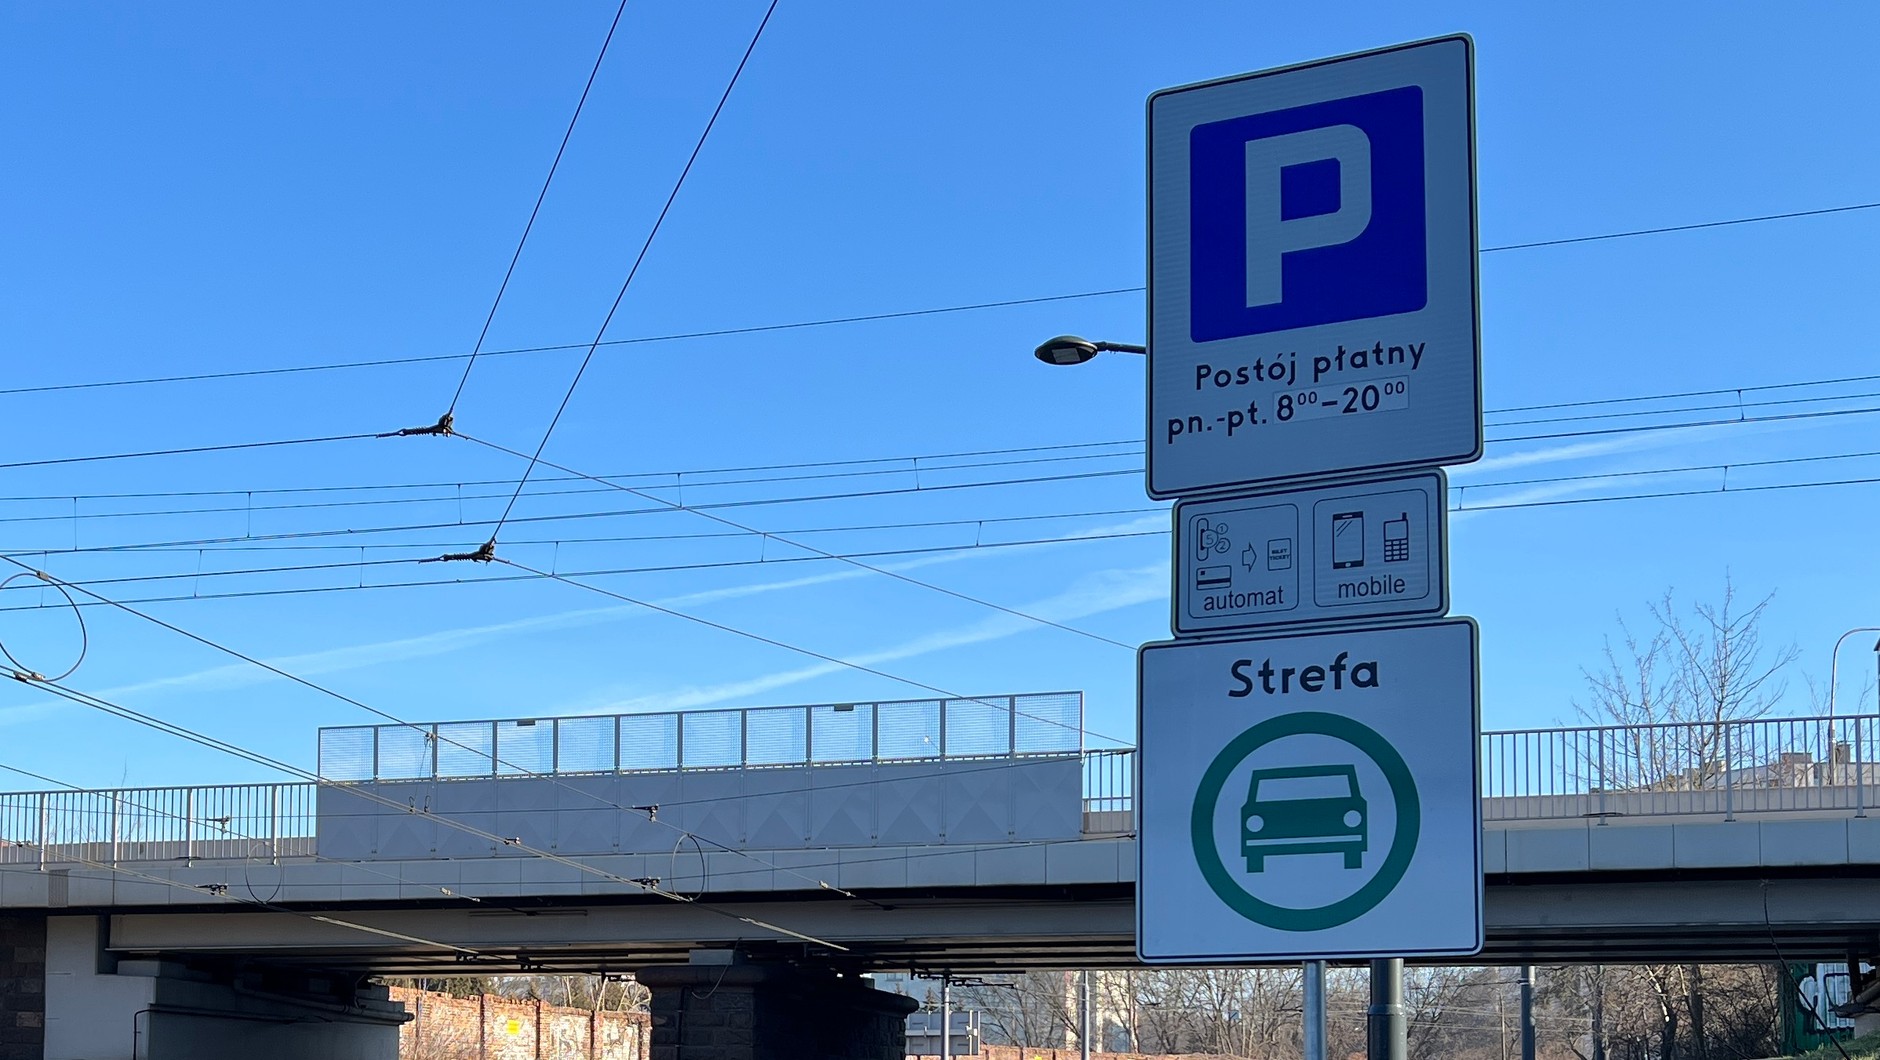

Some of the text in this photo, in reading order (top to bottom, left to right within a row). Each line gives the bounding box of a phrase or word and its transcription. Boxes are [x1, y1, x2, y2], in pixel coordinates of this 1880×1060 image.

[1245, 124, 1372, 308] P
[1196, 340, 1425, 390] Postój płatny
[1168, 400, 1267, 444] pn.-pt.
[1205, 534, 1214, 545] 5
[1203, 586, 1284, 611] automat
[1338, 574, 1406, 599] mobile
[1228, 651, 1379, 698] Strefa
